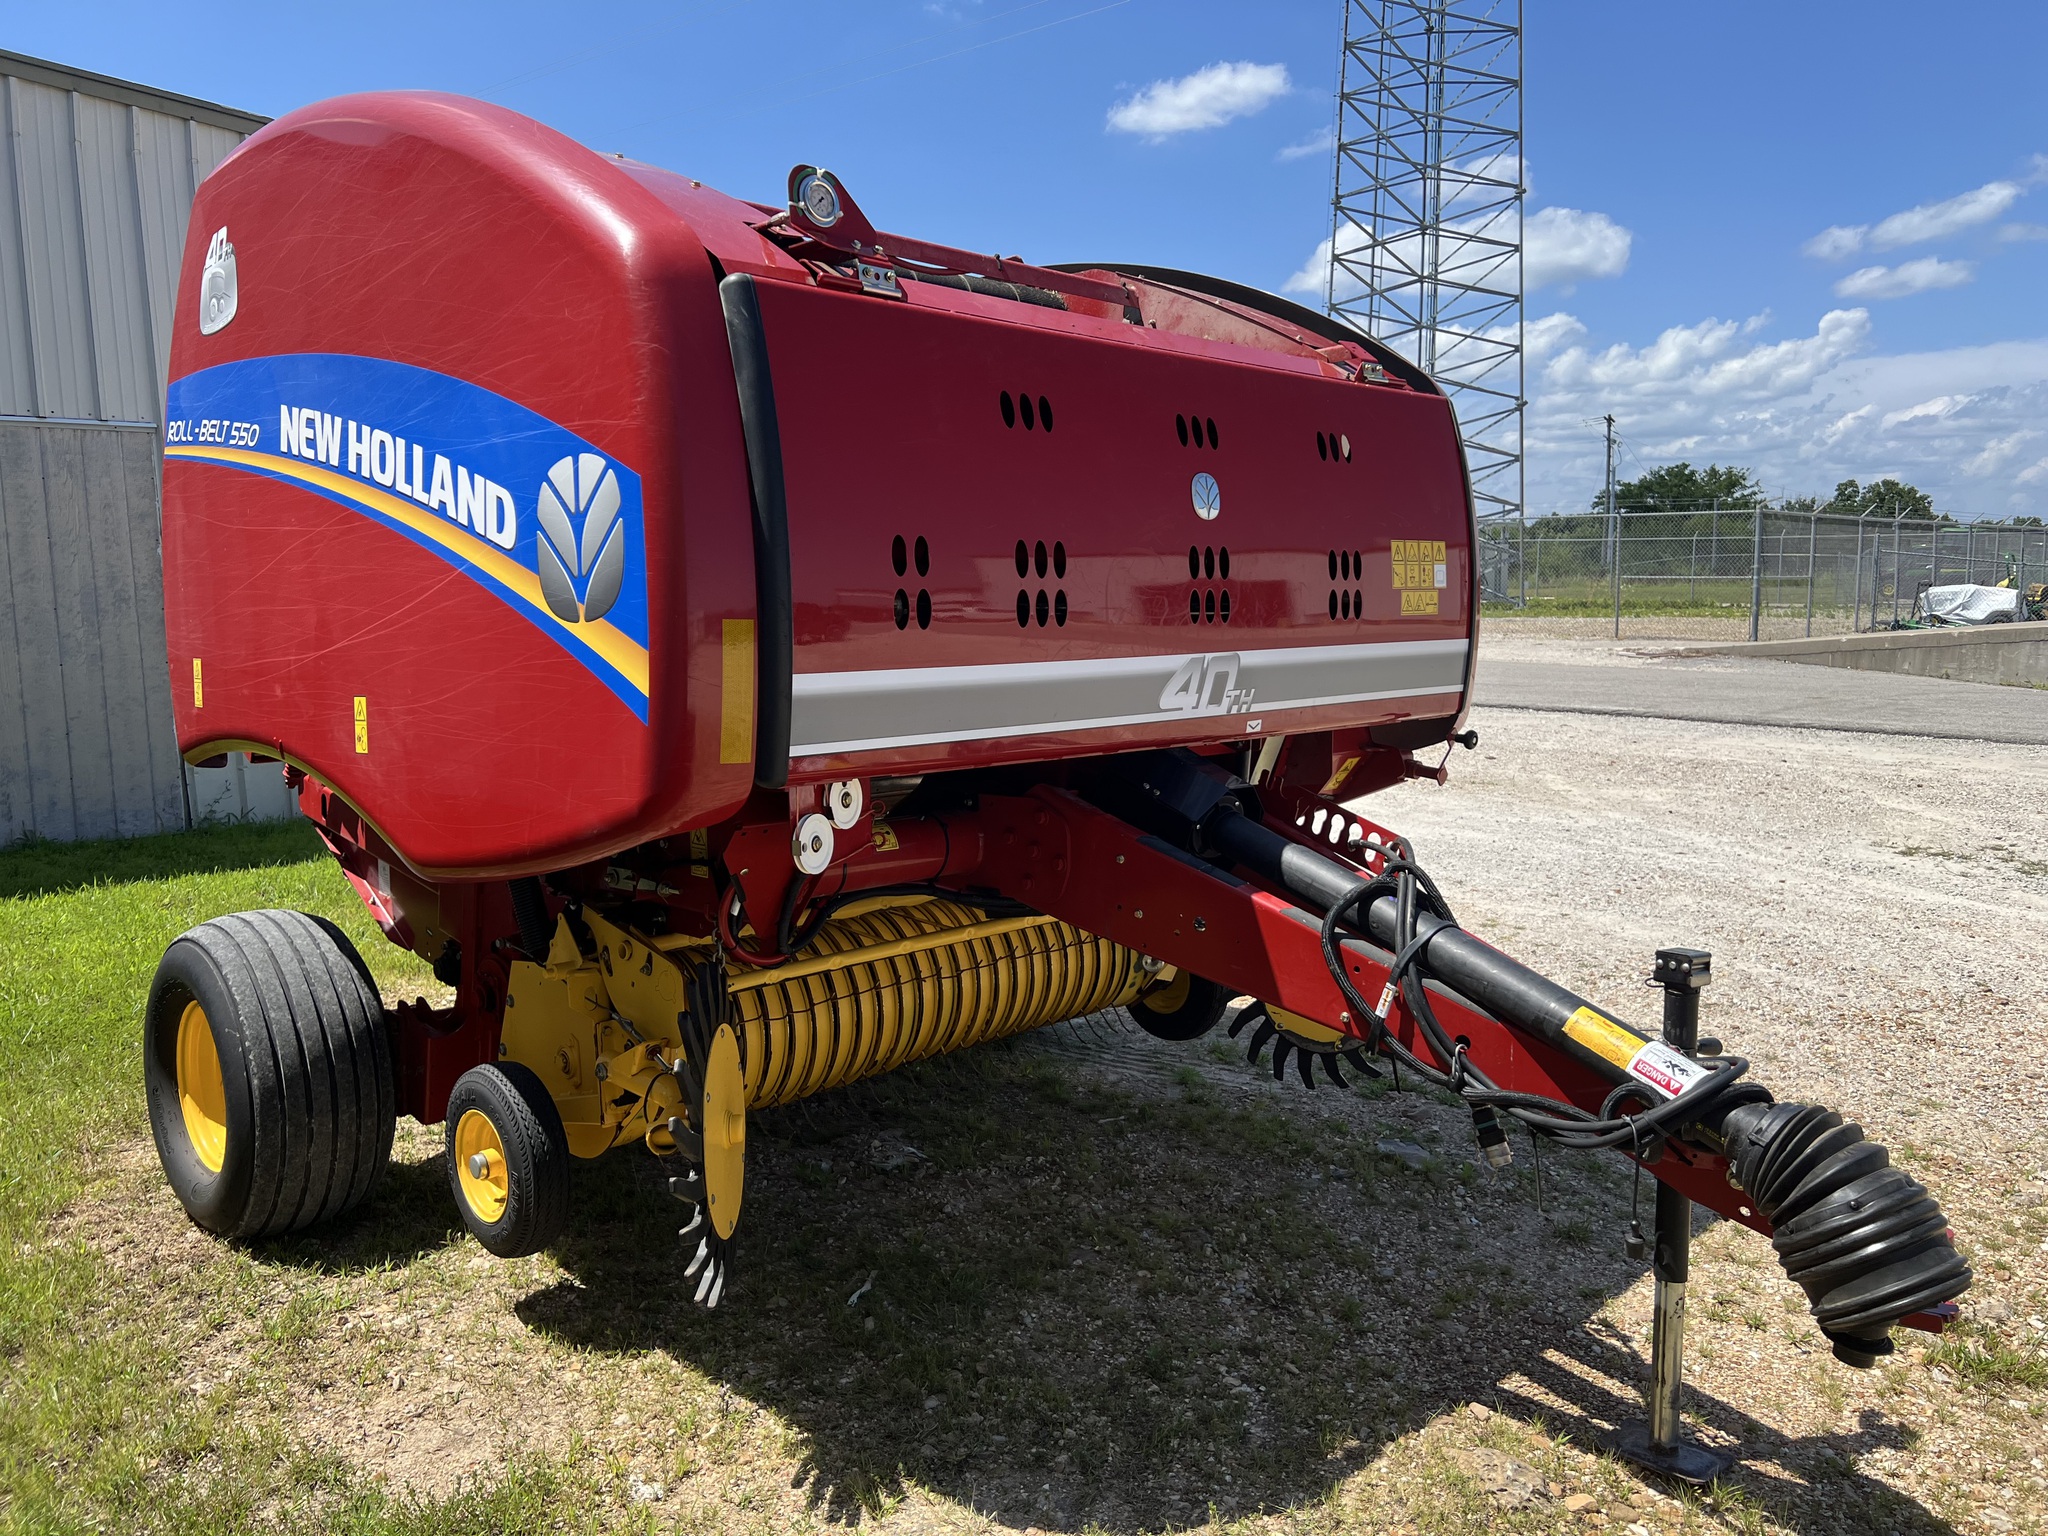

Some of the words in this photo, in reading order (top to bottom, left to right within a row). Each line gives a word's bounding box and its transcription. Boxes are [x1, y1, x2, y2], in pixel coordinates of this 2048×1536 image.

[167, 419, 230, 443] ROLL-BELT
[229, 422, 260, 447] 550
[280, 404, 342, 467] NEW
[348, 420, 517, 551] HOLLAND
[1635, 1060, 1669, 1086] DANGER
